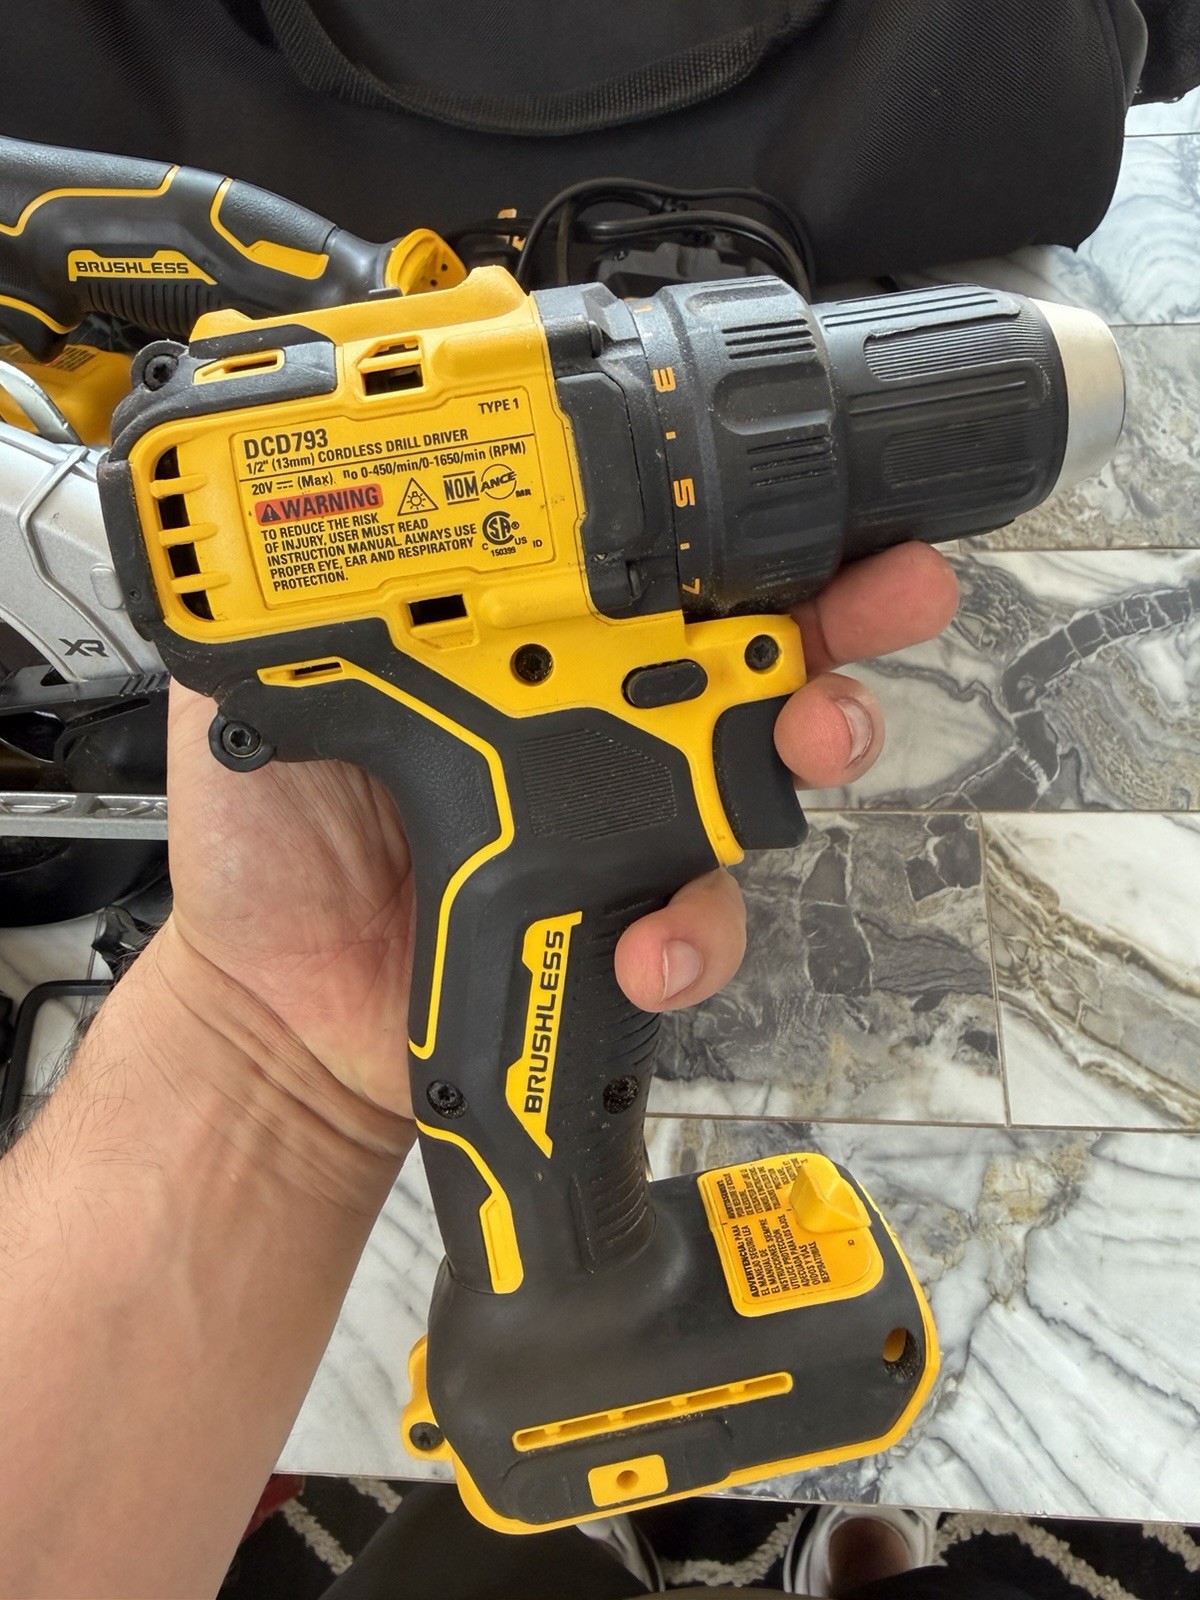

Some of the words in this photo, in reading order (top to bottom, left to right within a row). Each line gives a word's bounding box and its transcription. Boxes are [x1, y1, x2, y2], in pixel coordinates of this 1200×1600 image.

[75, 262, 188, 274] BRUSHLESS
[653, 367, 676, 392] 3
[478, 399, 510, 414] TYPE
[513, 398, 519, 409] 1
[244, 428, 328, 459] DCD793
[246, 460, 268, 475] 1/2"
[272, 453, 314, 471] (13mm)
[318, 442, 382, 462] CORDLESS
[386, 437, 421, 452] DRILL
[423, 429, 468, 446] DRIVER
[252, 482, 272, 495] 20V
[361, 449, 486, 478] 0-450/min/0-1650/min
[489, 441, 526, 459] (RPM)
[444, 476, 478, 500] NOM
[480, 471, 516, 492] ANCE
[673, 478, 695, 508] 5
[280, 486, 379, 519] WARNING
[262, 529, 276, 541] TO
[280, 521, 324, 538] REDUCE
[328, 517, 350, 530] THE
[352, 513, 379, 526] RISK
[265, 542, 279, 554] OF
[329, 530, 359, 544] USER
[362, 524, 395, 538] MUST
[398, 518, 428, 532] READ
[268, 544, 345, 567] INSTRUCTION
[348, 536, 402, 554] MANUAL.
[405, 528, 452, 545] ALWAYS
[454, 524, 477, 536] USE
[482, 542, 488, 550] C
[514, 537, 528, 545] US
[532, 540, 542, 548] ID
[270, 562, 316, 579] PROPER
[318, 558, 342, 572] EYE,
[345, 555, 368, 568] EAR
[370, 550, 395, 564] AND
[398, 537, 474, 559] RESPIRATORY
[273, 570, 348, 592] PROTECTION.
[682, 578, 700, 595] 7
[58, 638, 110, 658] XR
[524, 930, 564, 1113] BRUSHLESS
[731, 1225, 742, 1241] PARA
[741, 1225, 751, 1236] LEA
[783, 1229, 793, 1240] LOS
[744, 1236, 759, 1260] SEGURO
[759, 1248, 769, 1257] DE
[787, 1240, 798, 1255] PARA
[752, 1260, 767, 1288] MANEJO
[762, 1258, 777, 1285] MANUAL
[785, 1265, 800, 1289] UTILICE
[792, 1255, 811, 1288] ADECUADA
[760, 1288, 770, 1296] EL
[771, 1286, 780, 1294] EL
